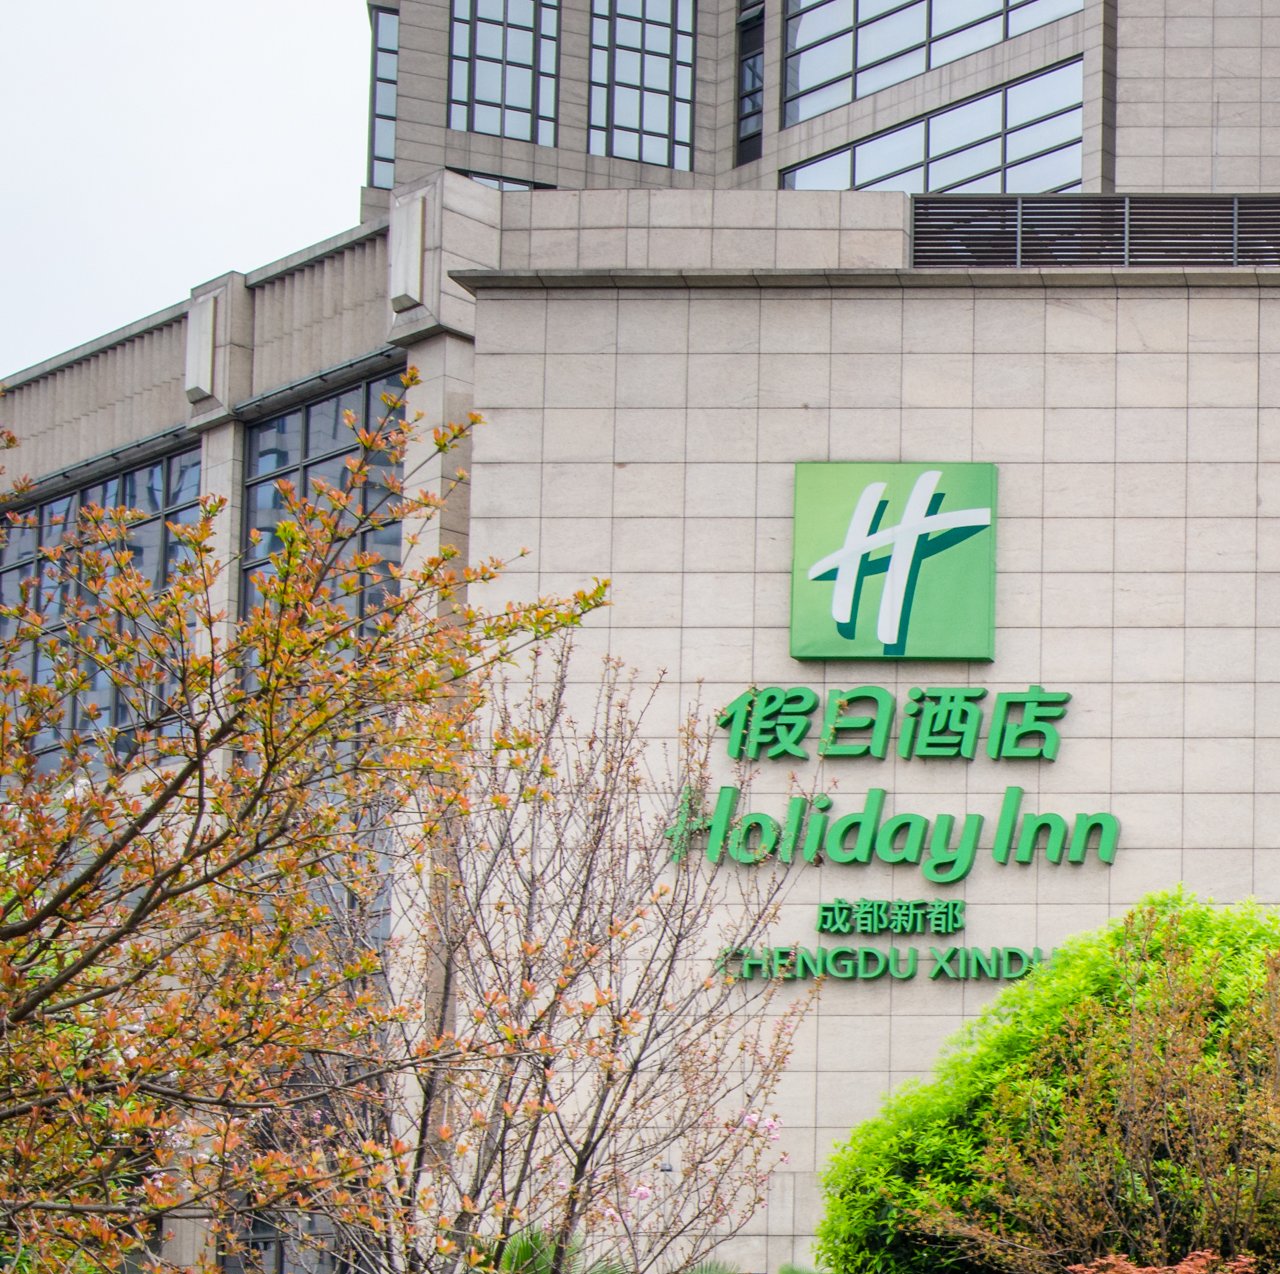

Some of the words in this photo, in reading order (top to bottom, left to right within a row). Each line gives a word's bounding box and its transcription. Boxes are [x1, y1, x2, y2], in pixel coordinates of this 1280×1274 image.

[719, 685, 1072, 761] 假日酒店
[666, 786, 984, 884] Holiday
[992, 786, 1121, 865] Inn
[815, 898, 967, 936] 成都新都
